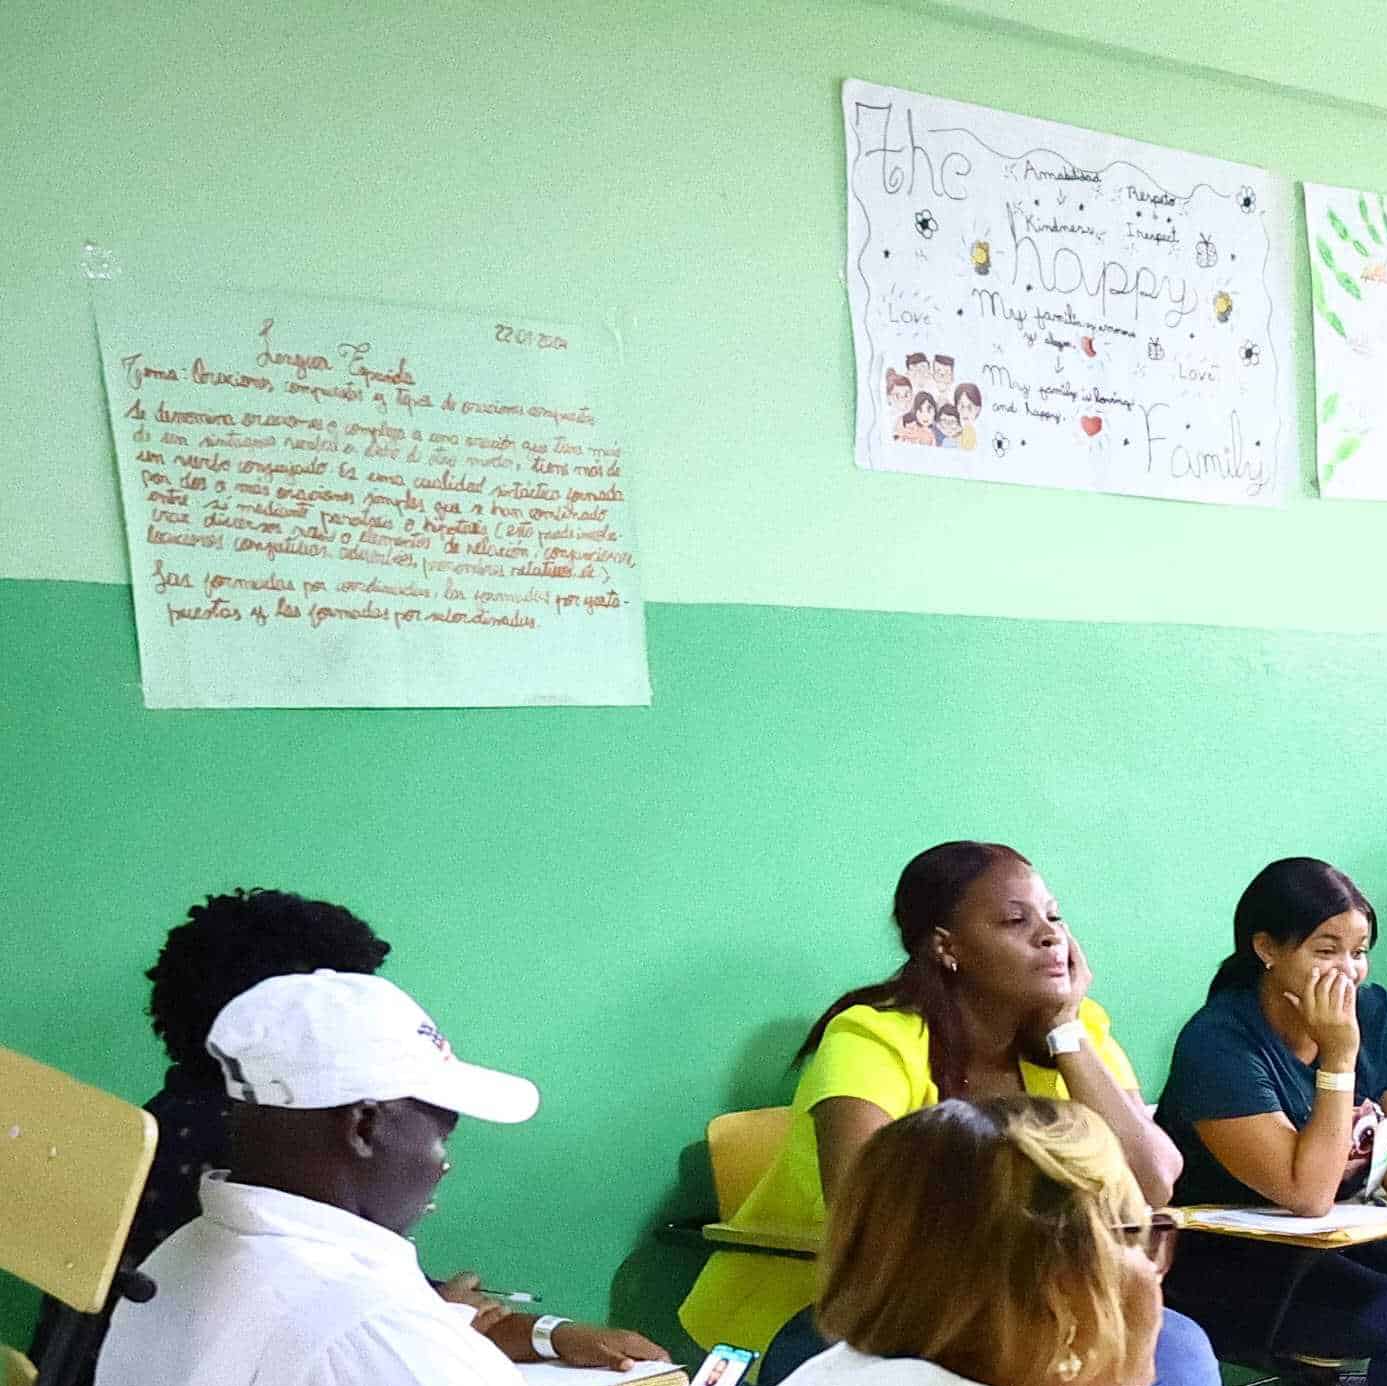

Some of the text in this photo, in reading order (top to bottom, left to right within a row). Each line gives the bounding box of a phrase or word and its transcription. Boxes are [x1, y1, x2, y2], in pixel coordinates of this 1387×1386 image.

[855, 101, 971, 202] The
[1005, 201, 1199, 329] happy
[888, 302, 932, 326] Love
[1178, 362, 1217, 382] Love
[1137, 402, 1271, 497] Family
